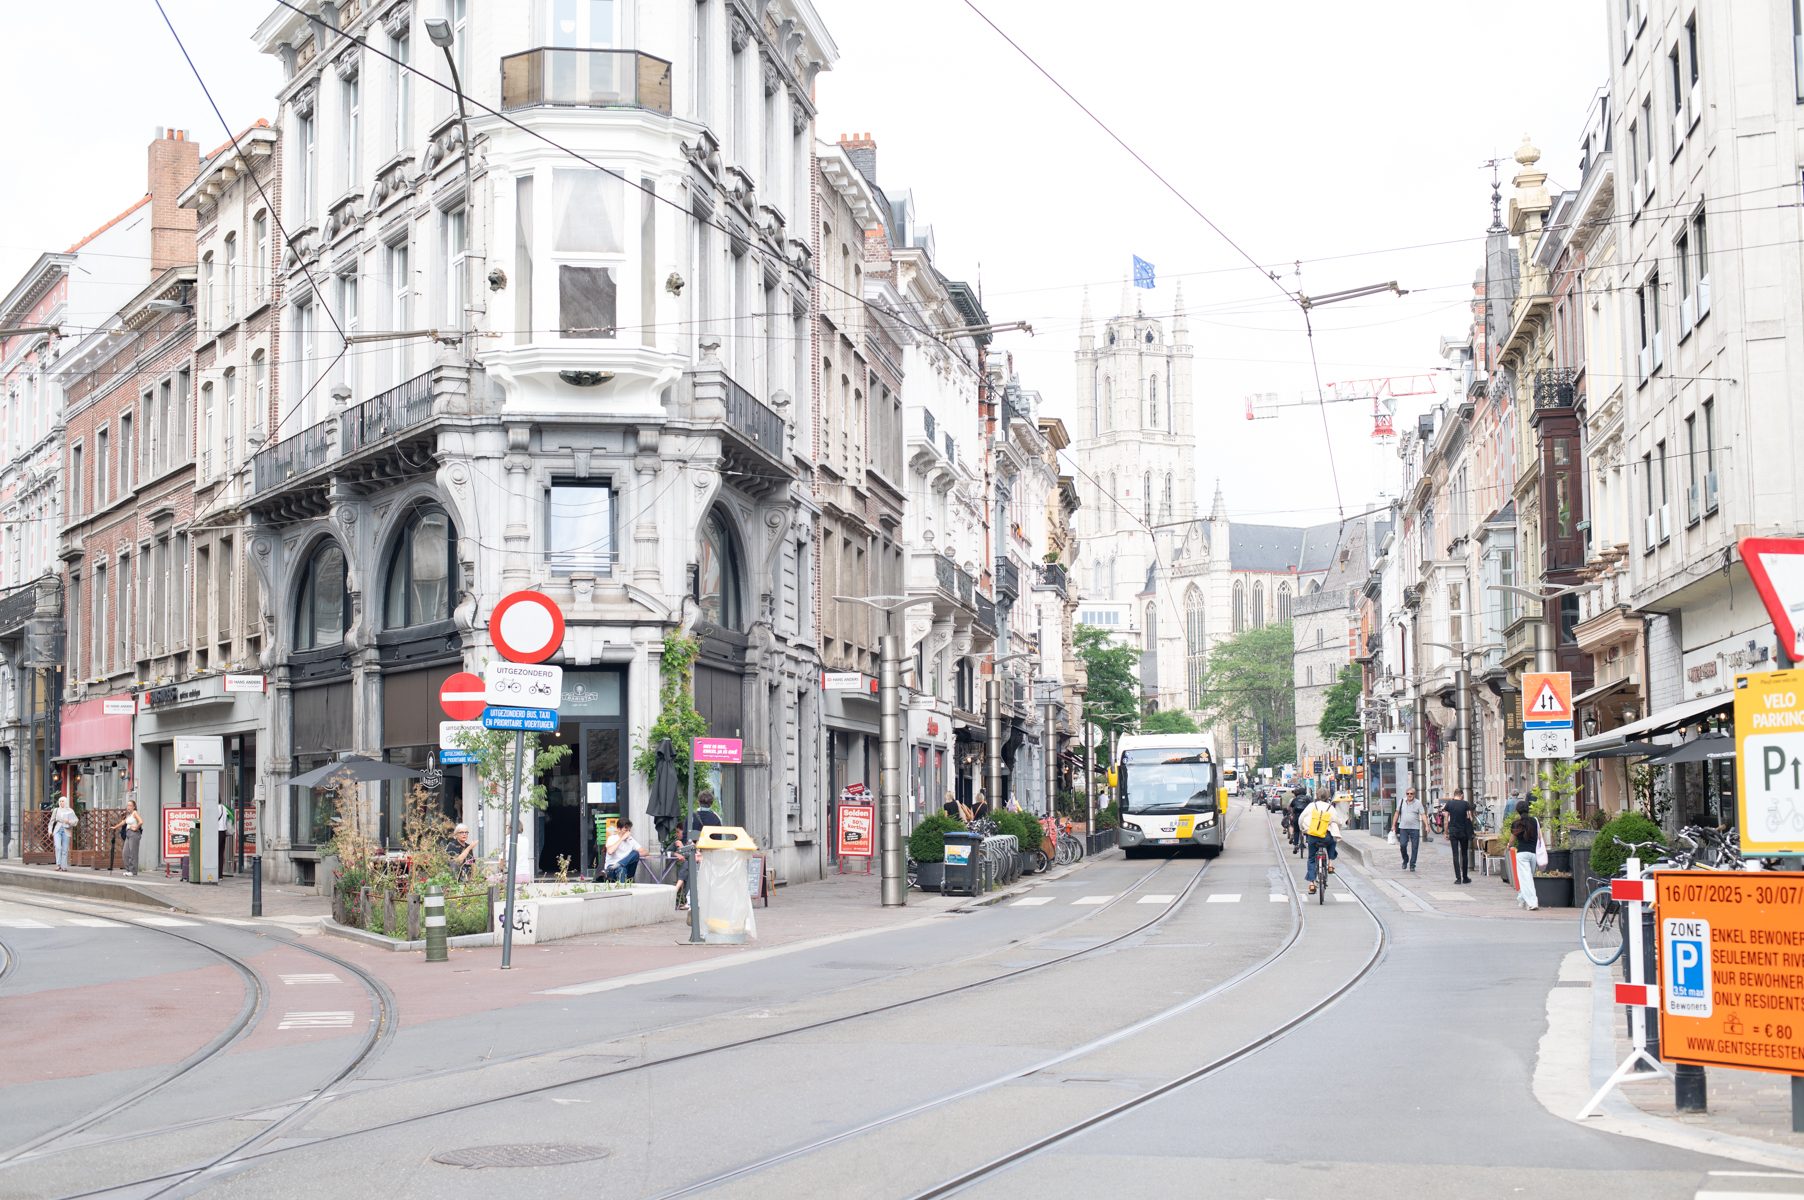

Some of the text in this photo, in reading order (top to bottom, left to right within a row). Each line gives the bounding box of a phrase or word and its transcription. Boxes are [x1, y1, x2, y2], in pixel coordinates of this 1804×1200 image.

[497, 667, 553, 678] UITGEZONDERD
[1763, 692, 1796, 709] VELO
[490, 709, 550, 719] UITGEZONDERD BUS, TAXI
[493, 719, 522, 728] PRIORITAIRE
[524, 720, 554, 729] VOERTUIGEN
[1763, 746, 1786, 791] P
[843, 809, 868, 817] Solden
[1666, 885, 1742, 904] 16/07/2025
[1671, 923, 1702, 937] ZONE
[1712, 929, 1747, 944] ENKEL
[1676, 943, 1698, 985] P
[1712, 950, 1778, 967] SEULEMENT
[1713, 971, 1736, 986] NUR
[1671, 1000, 1708, 1011] Bewoners
[1714, 992, 1741, 1006] ONLY
[1777, 1025, 1792, 1040] 80
[1687, 1037, 1804, 1060] WWW.GENTSEFEESTEN
